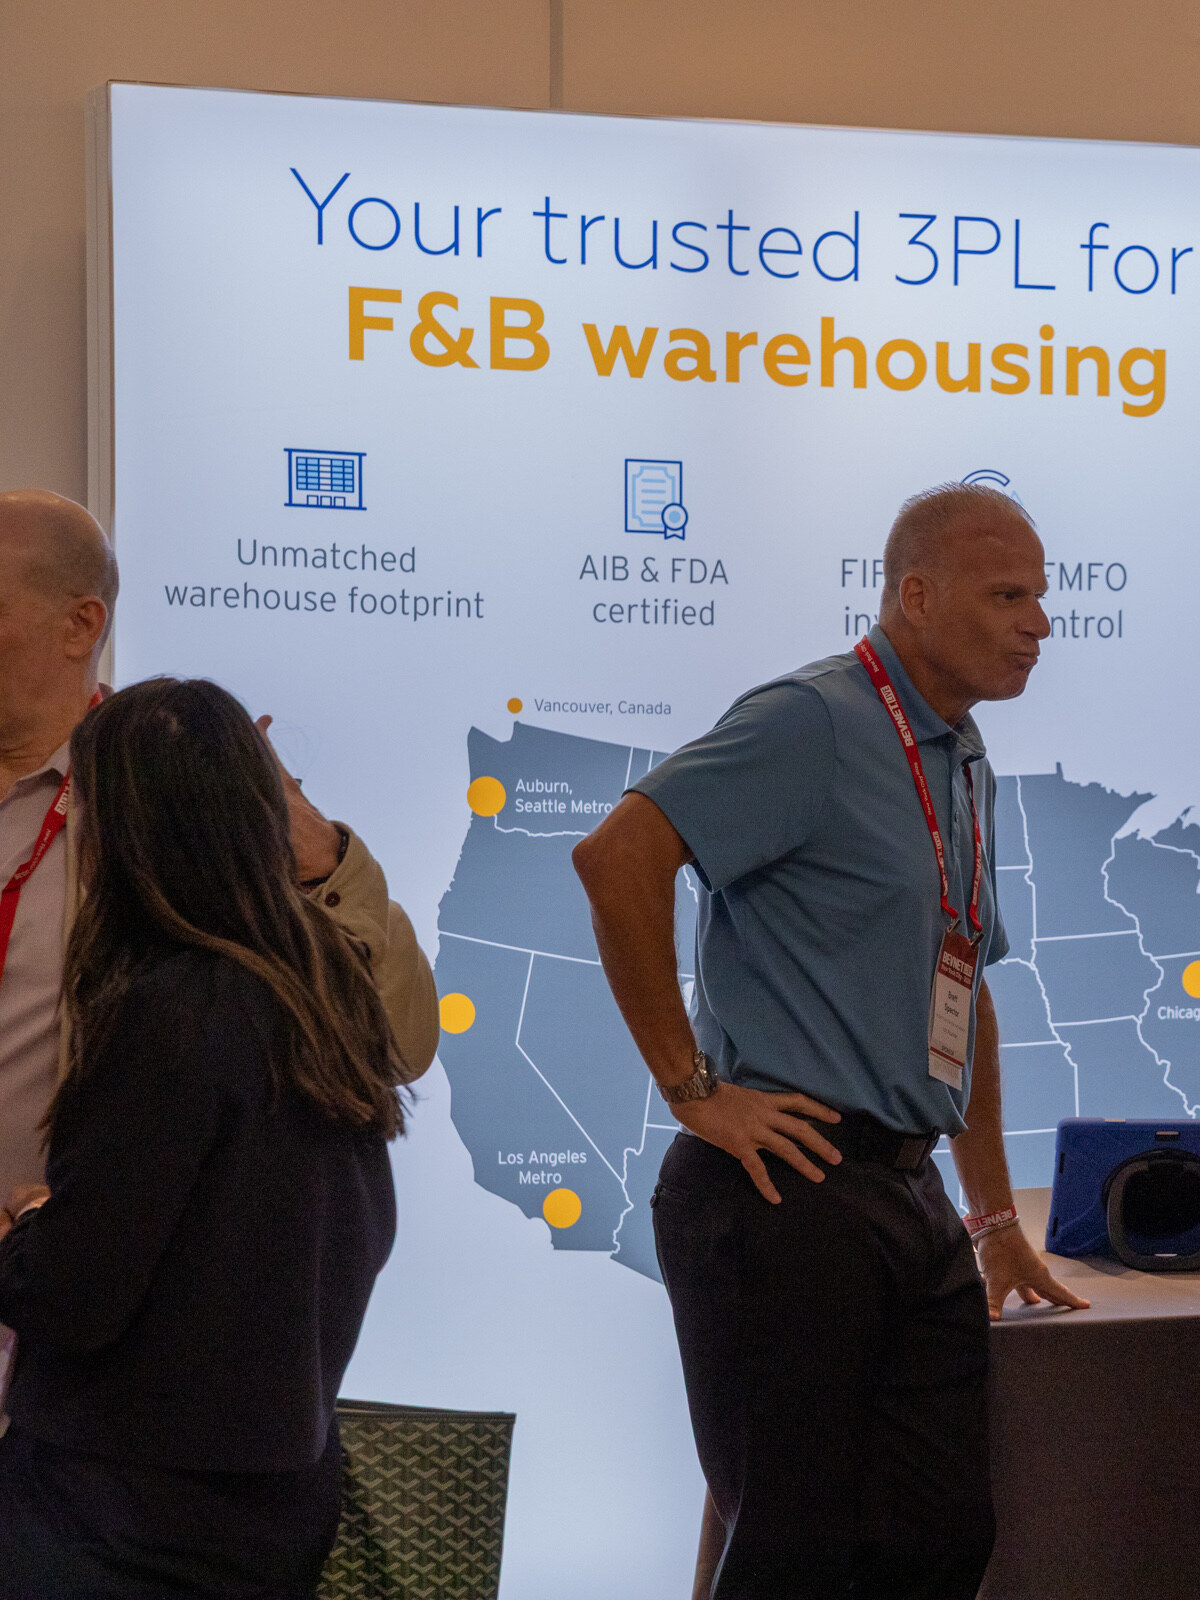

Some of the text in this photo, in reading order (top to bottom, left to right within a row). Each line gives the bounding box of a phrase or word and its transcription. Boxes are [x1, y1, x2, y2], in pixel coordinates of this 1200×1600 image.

[289, 167, 1194, 295] Your trusted 3PL for
[348, 286, 1167, 418] F&B warehousing
[237, 538, 416, 574] Unmatched
[578, 554, 729, 585] AIB & FDA
[841, 559, 883, 588] FIF
[164, 581, 485, 622] warehouse footprint
[592, 597, 715, 627] certified
[1050, 609, 1123, 638] ntrol
[535, 698, 672, 715] Vancouver, Canada
[880, 685, 897, 704] LIVE
[515, 778, 573, 795] Auburn,
[515, 798, 613, 814] Seattle Metro
[498, 1149, 588, 1167] Los Angeles
[519, 1170, 562, 1185] Metro
